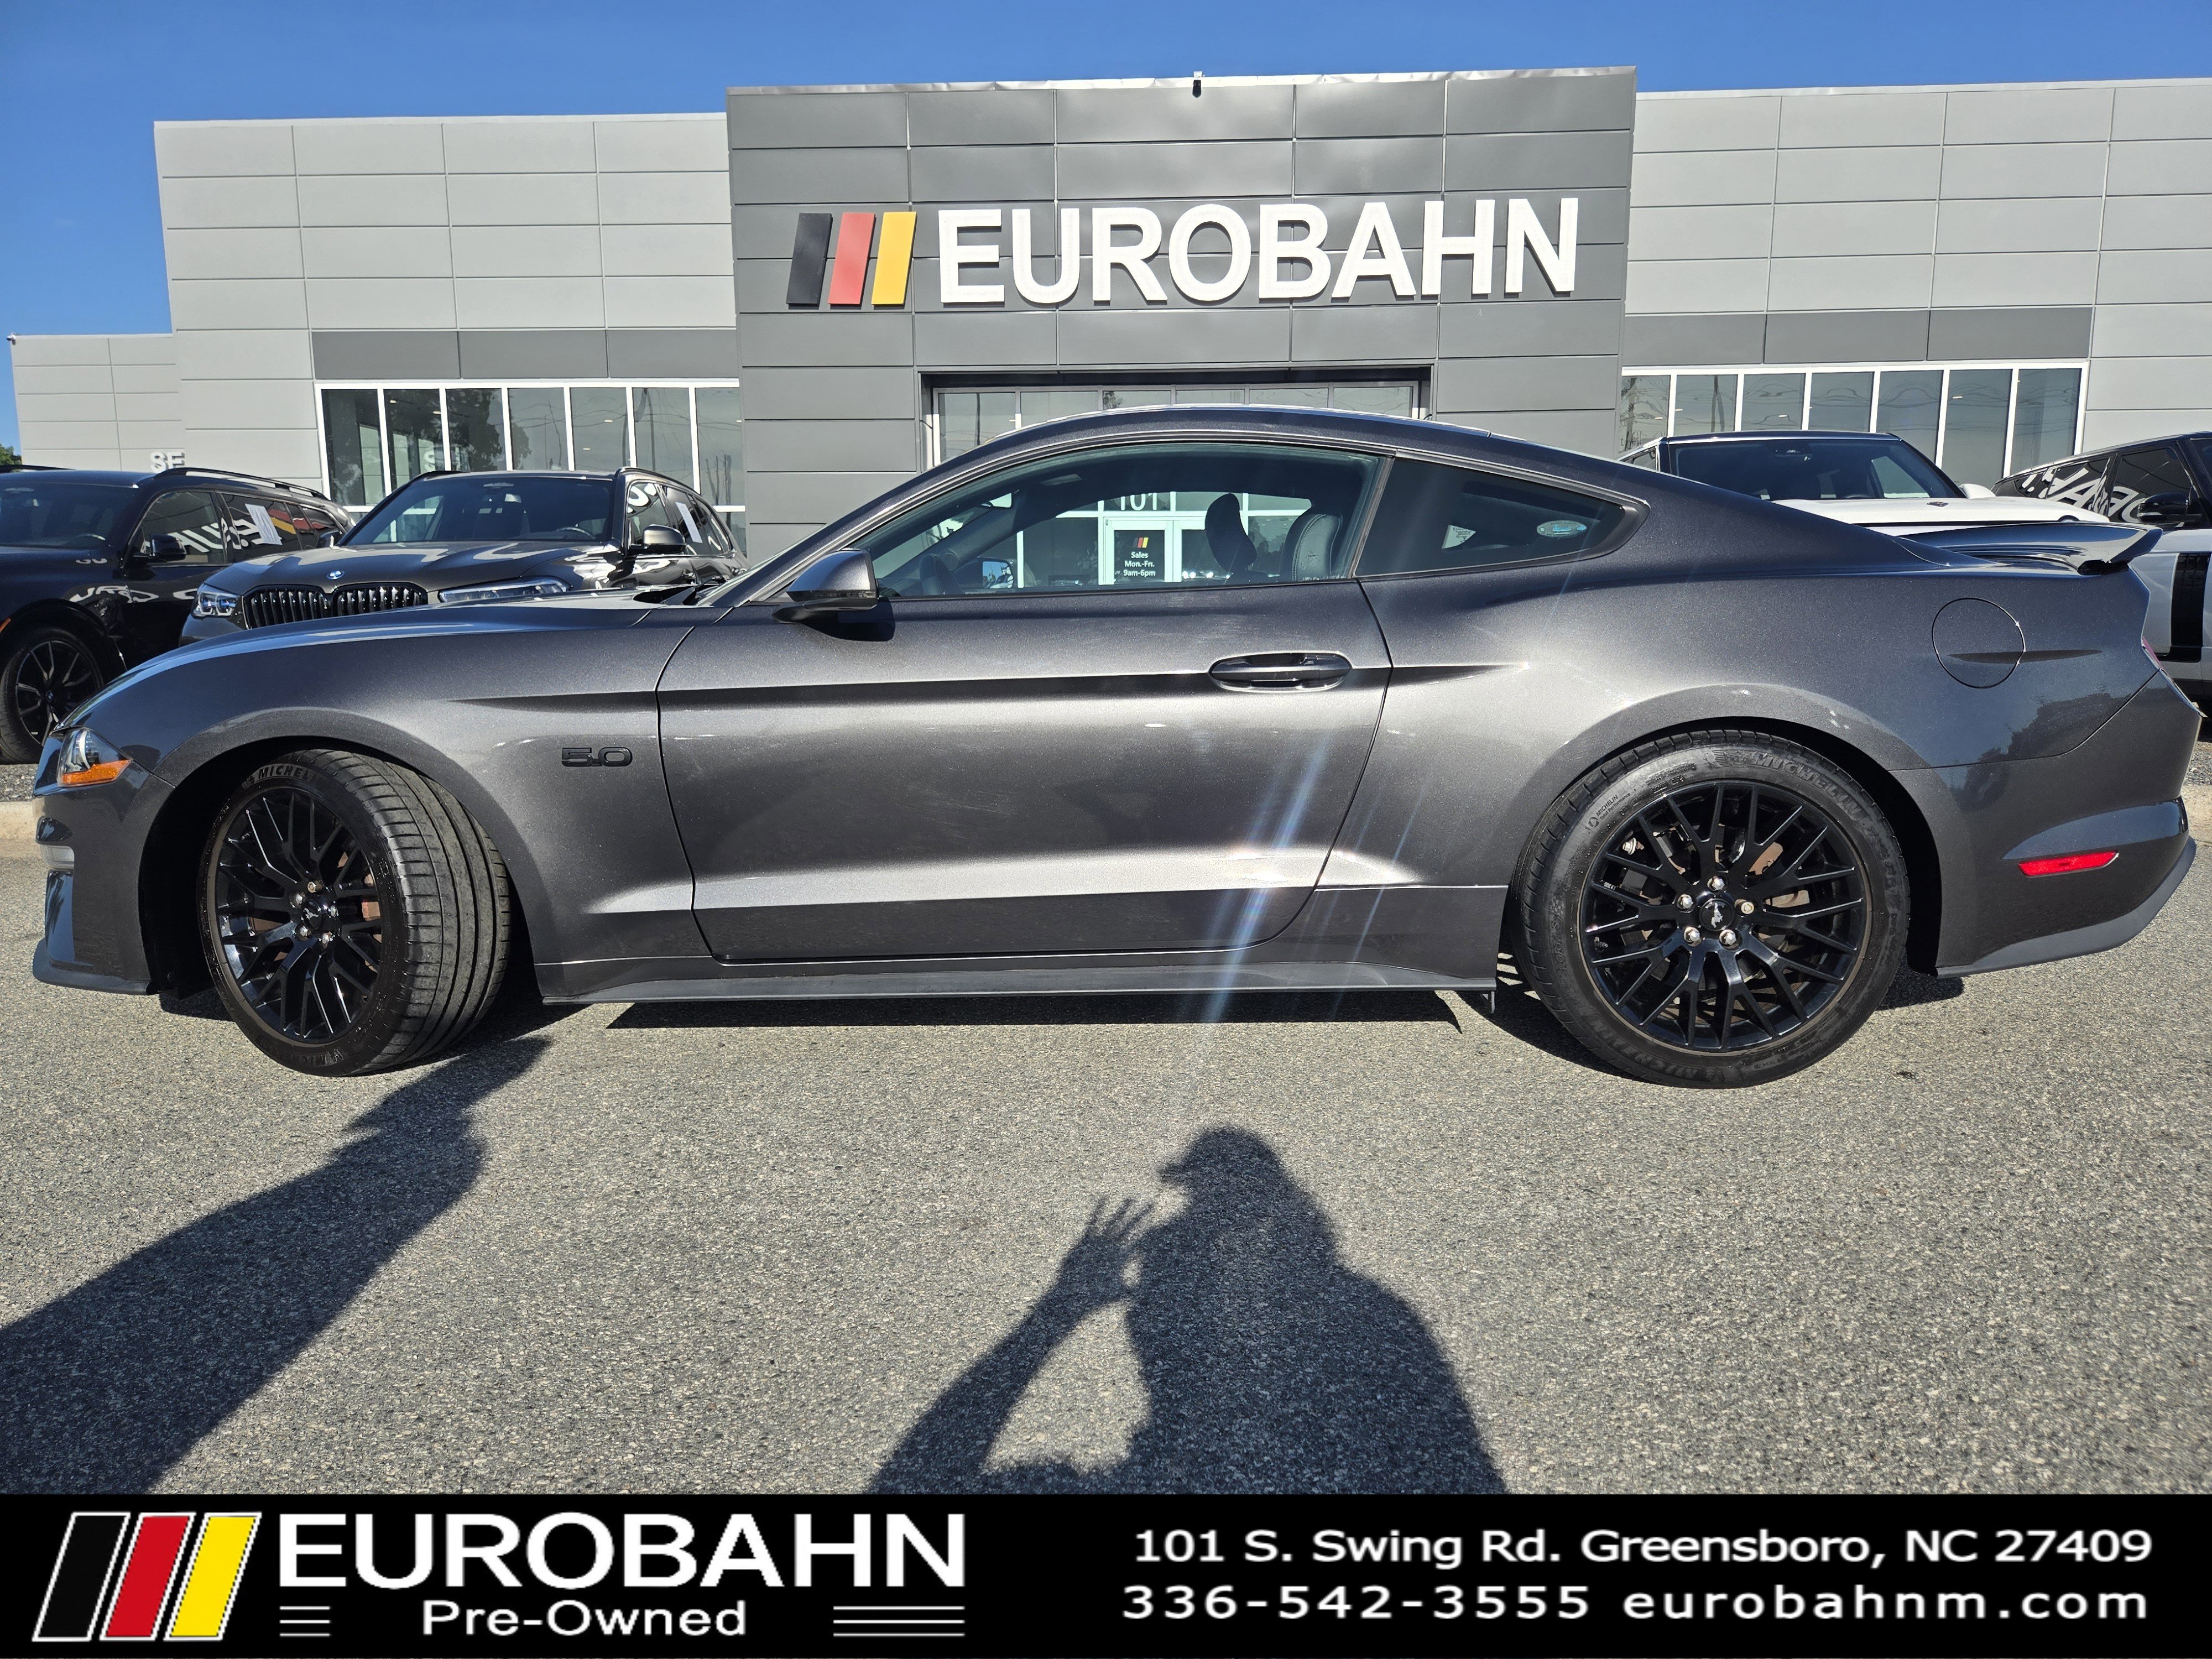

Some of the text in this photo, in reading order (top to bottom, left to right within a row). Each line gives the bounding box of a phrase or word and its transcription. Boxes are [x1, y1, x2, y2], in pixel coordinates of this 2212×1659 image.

[938, 197, 1578, 304] EUROBAHN
[561, 747, 633, 767] 5.0
[1751, 751, 1867, 821] MICHELIN
[1596, 795, 1618, 816] MICHELIN
[1600, 810, 1609, 820] Total
[1608, 792, 1631, 813] Performance
